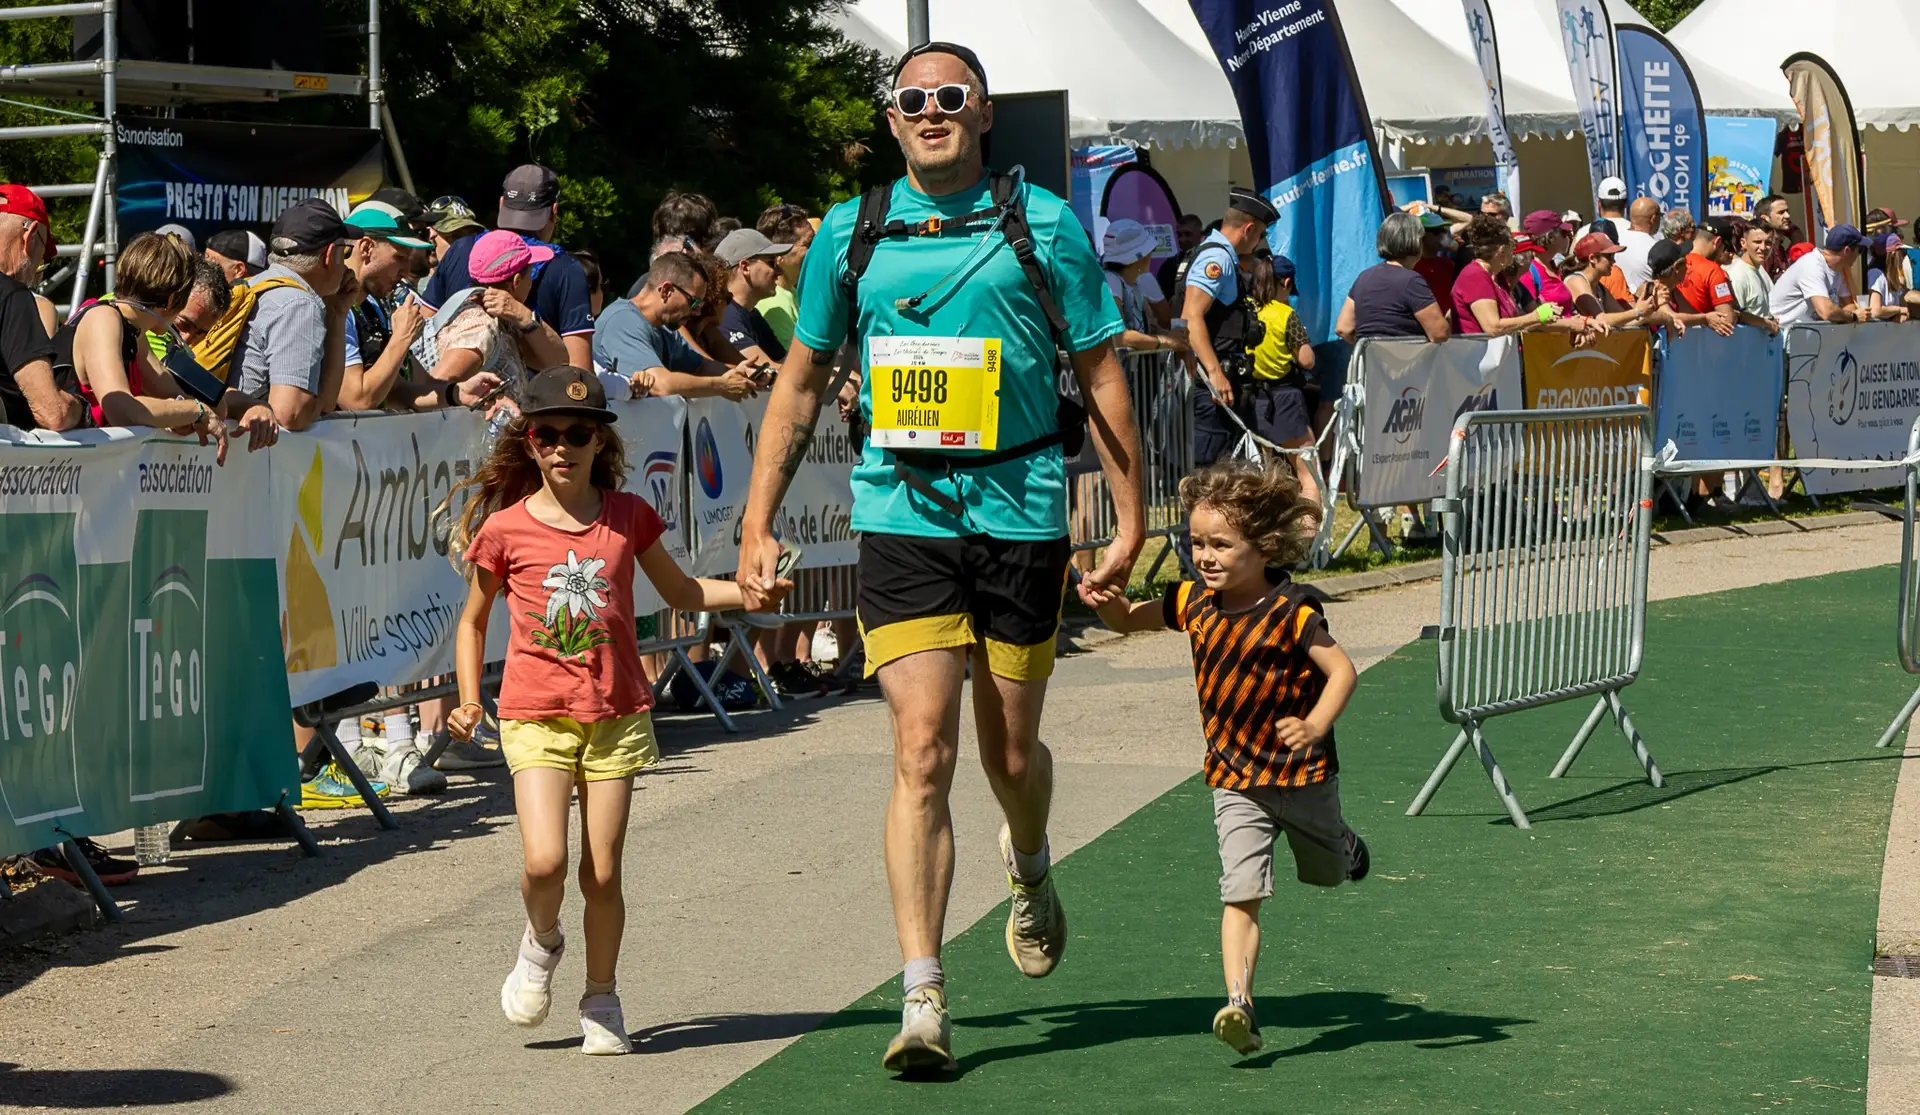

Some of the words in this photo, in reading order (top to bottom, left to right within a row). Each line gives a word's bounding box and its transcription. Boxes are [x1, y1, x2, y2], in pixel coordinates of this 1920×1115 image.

[1226, 46, 1251, 72] Notre
[1249, 9, 1325, 54] Département
[1235, 0, 1301, 44] Haute-Vienne
[117, 126, 183, 147] Sonorisation
[166, 182, 259, 222] PRESTA'SON
[986, 349, 997, 373] 9498
[1860, 362, 1888, 384] CAISSE
[892, 369, 948, 404] 9498
[1858, 391, 1870, 411] DU
[896, 405, 940, 427] AURÉLIEN
[1382, 397, 1426, 434] AGPM
[806, 424, 854, 464] outien
[138, 455, 213, 494] association
[703, 505, 734, 525] LIMOGES
[800, 504, 818, 545] de
[341, 604, 387, 665] Ville
